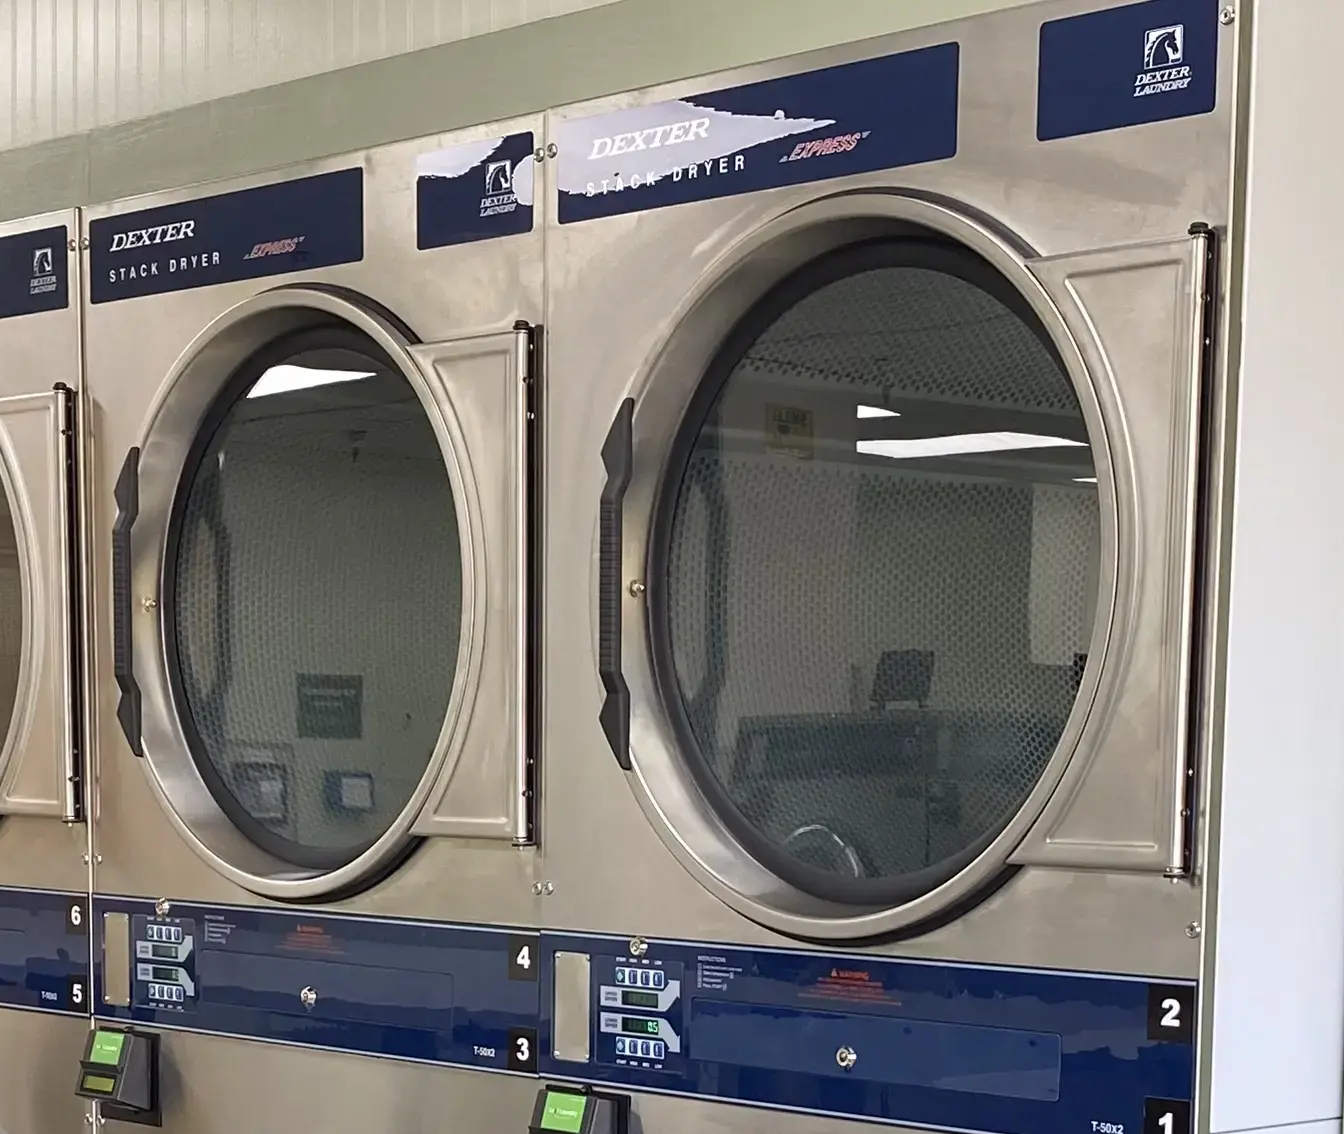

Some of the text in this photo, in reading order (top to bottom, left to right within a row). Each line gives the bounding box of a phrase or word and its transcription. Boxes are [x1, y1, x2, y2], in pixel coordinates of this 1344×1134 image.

[1133, 77, 1192, 97] LAUNDRY
[1134, 65, 1190, 86] DEXTER
[586, 117, 711, 161] DEXTER
[787, 130, 861, 162] EXPRESS
[585, 153, 746, 198] STACK DRYER
[108, 219, 196, 252] DEXTER
[108, 251, 221, 283] STACK DRYER
[71, 905, 82, 926] 6
[516, 945, 531, 969] 4
[72, 983, 83, 1003] 5
[1160, 998, 1181, 1028] 2
[515, 1037, 530, 1061] 3
[1091, 1121, 1124, 1134] T-50X2
